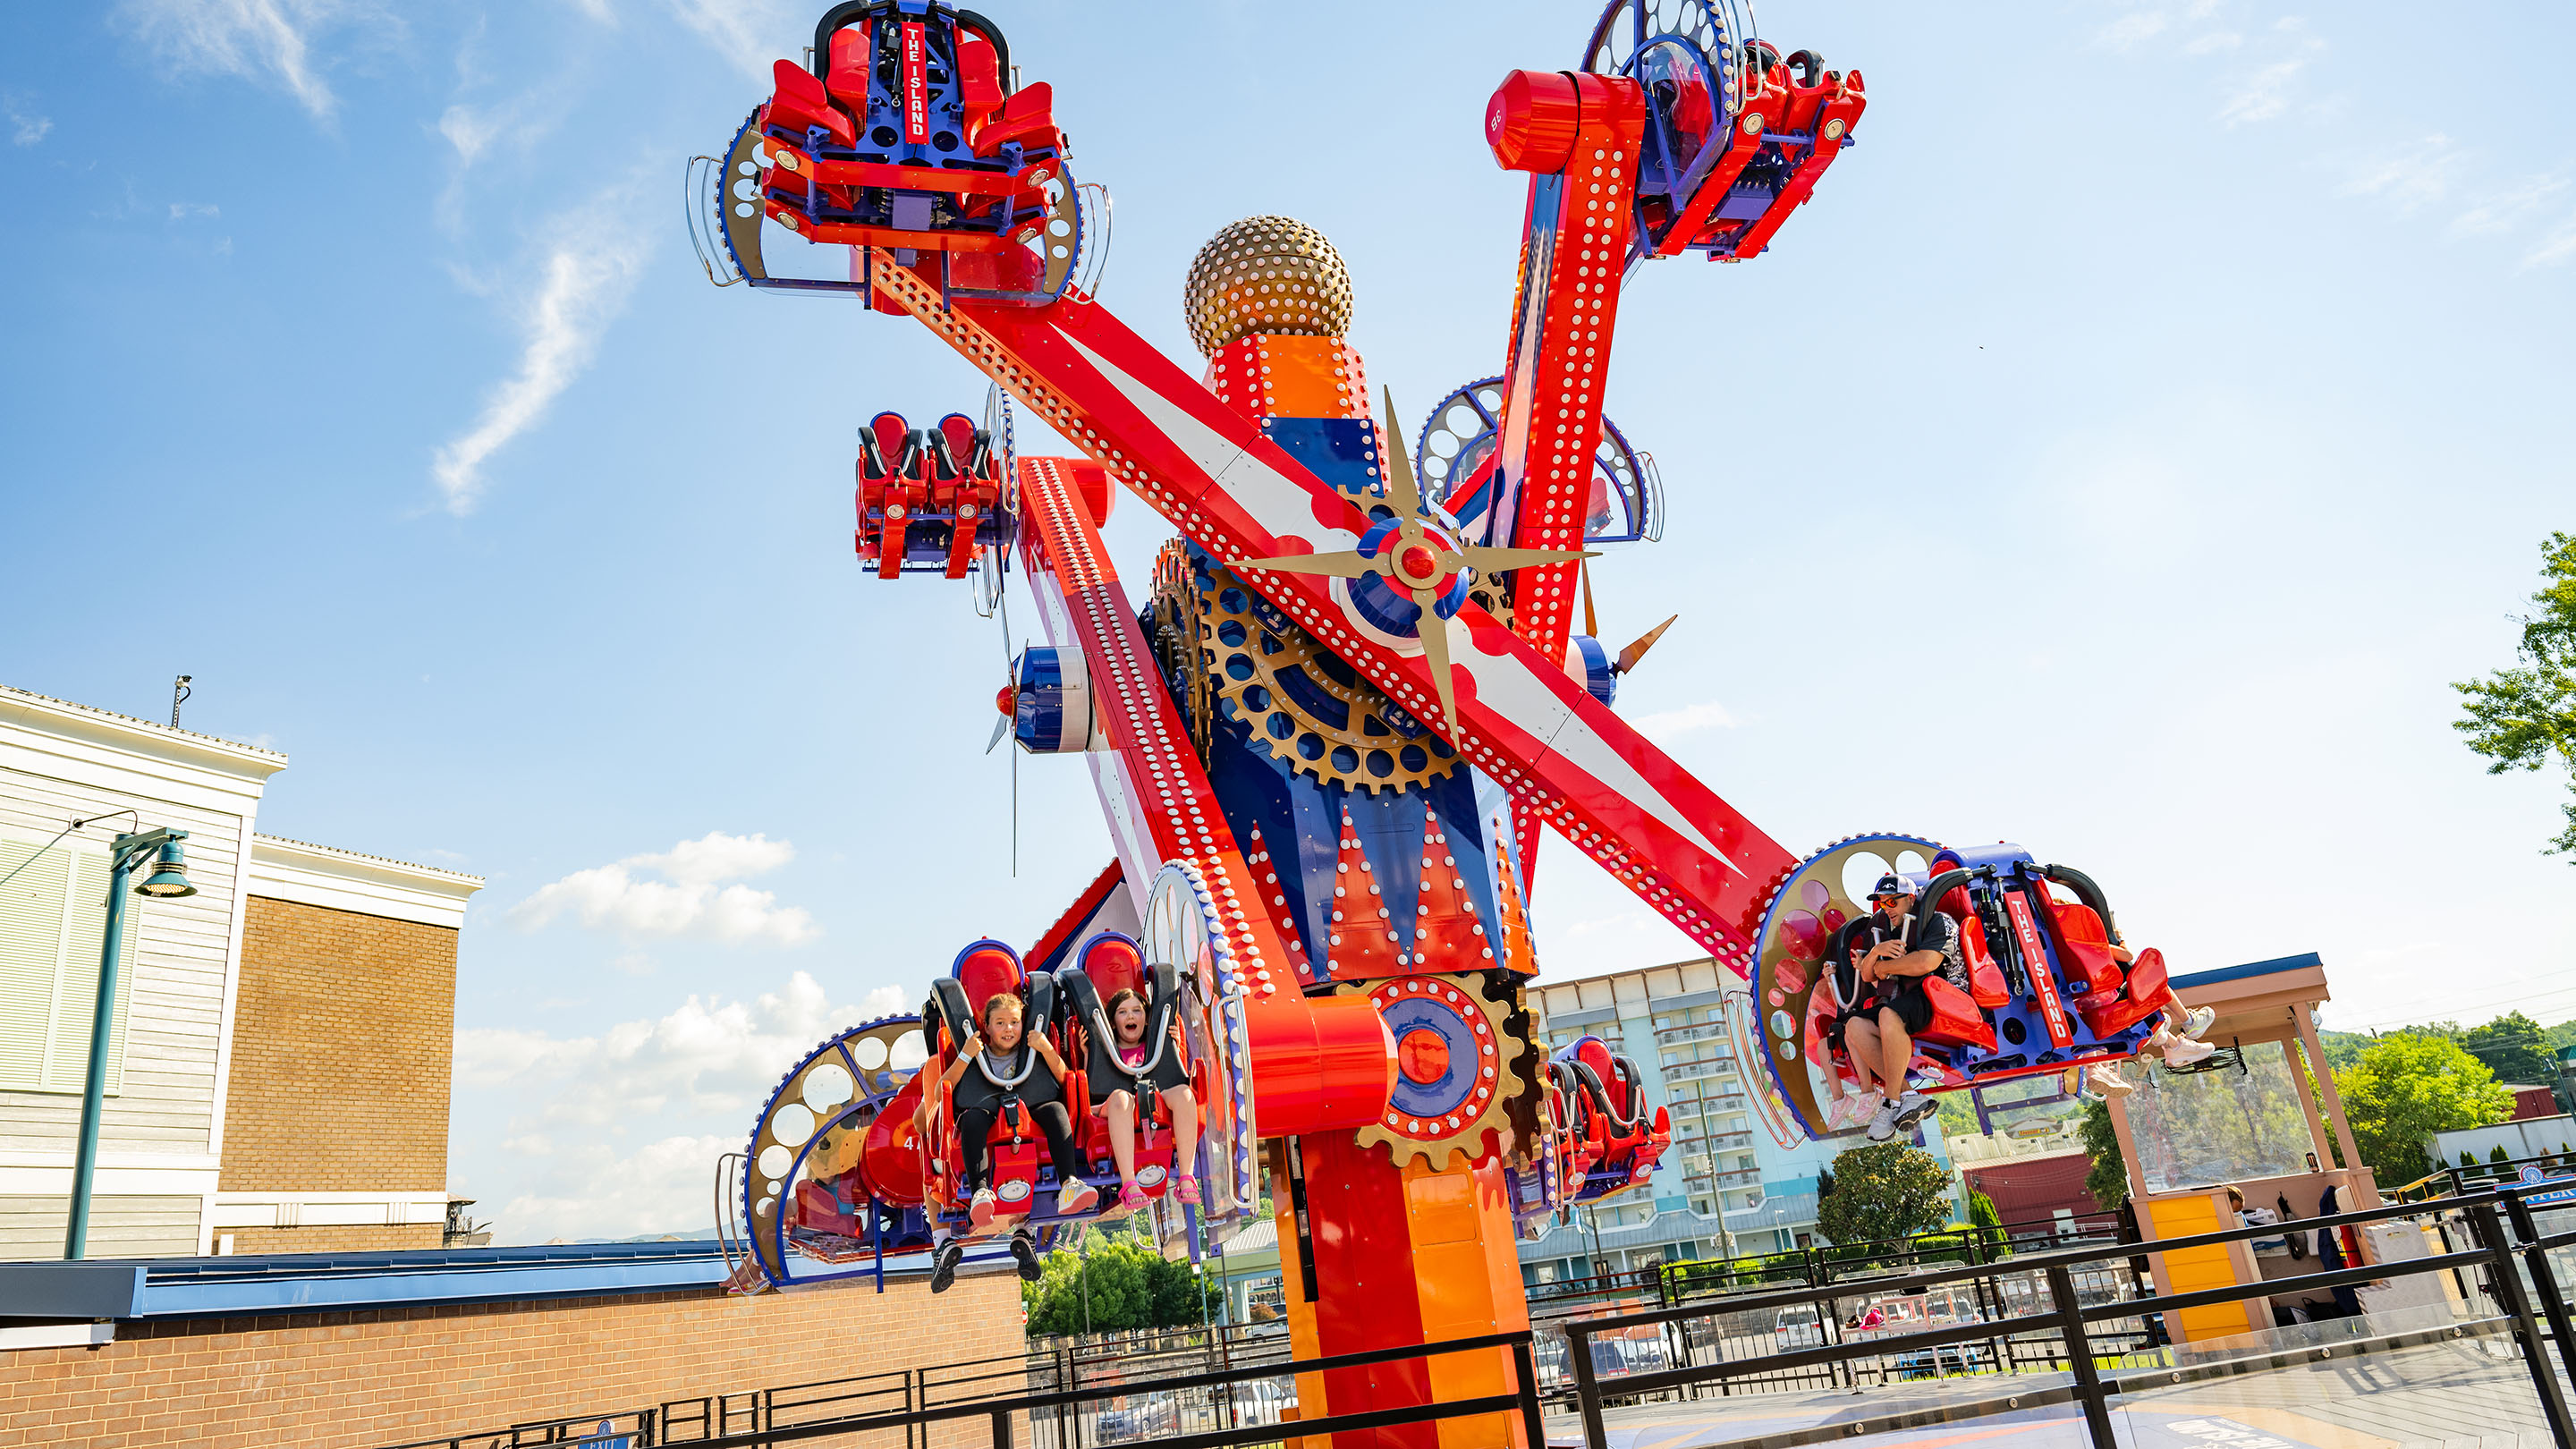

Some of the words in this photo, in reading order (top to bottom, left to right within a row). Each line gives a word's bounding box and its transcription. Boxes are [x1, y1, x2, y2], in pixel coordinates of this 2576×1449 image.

[907, 28, 919, 62] THE
[910, 65, 924, 136] ISLAND
[1491, 109, 1502, 131] 3B
[2012, 900, 2034, 944] THE
[2030, 947, 2067, 1038] ISLAND
